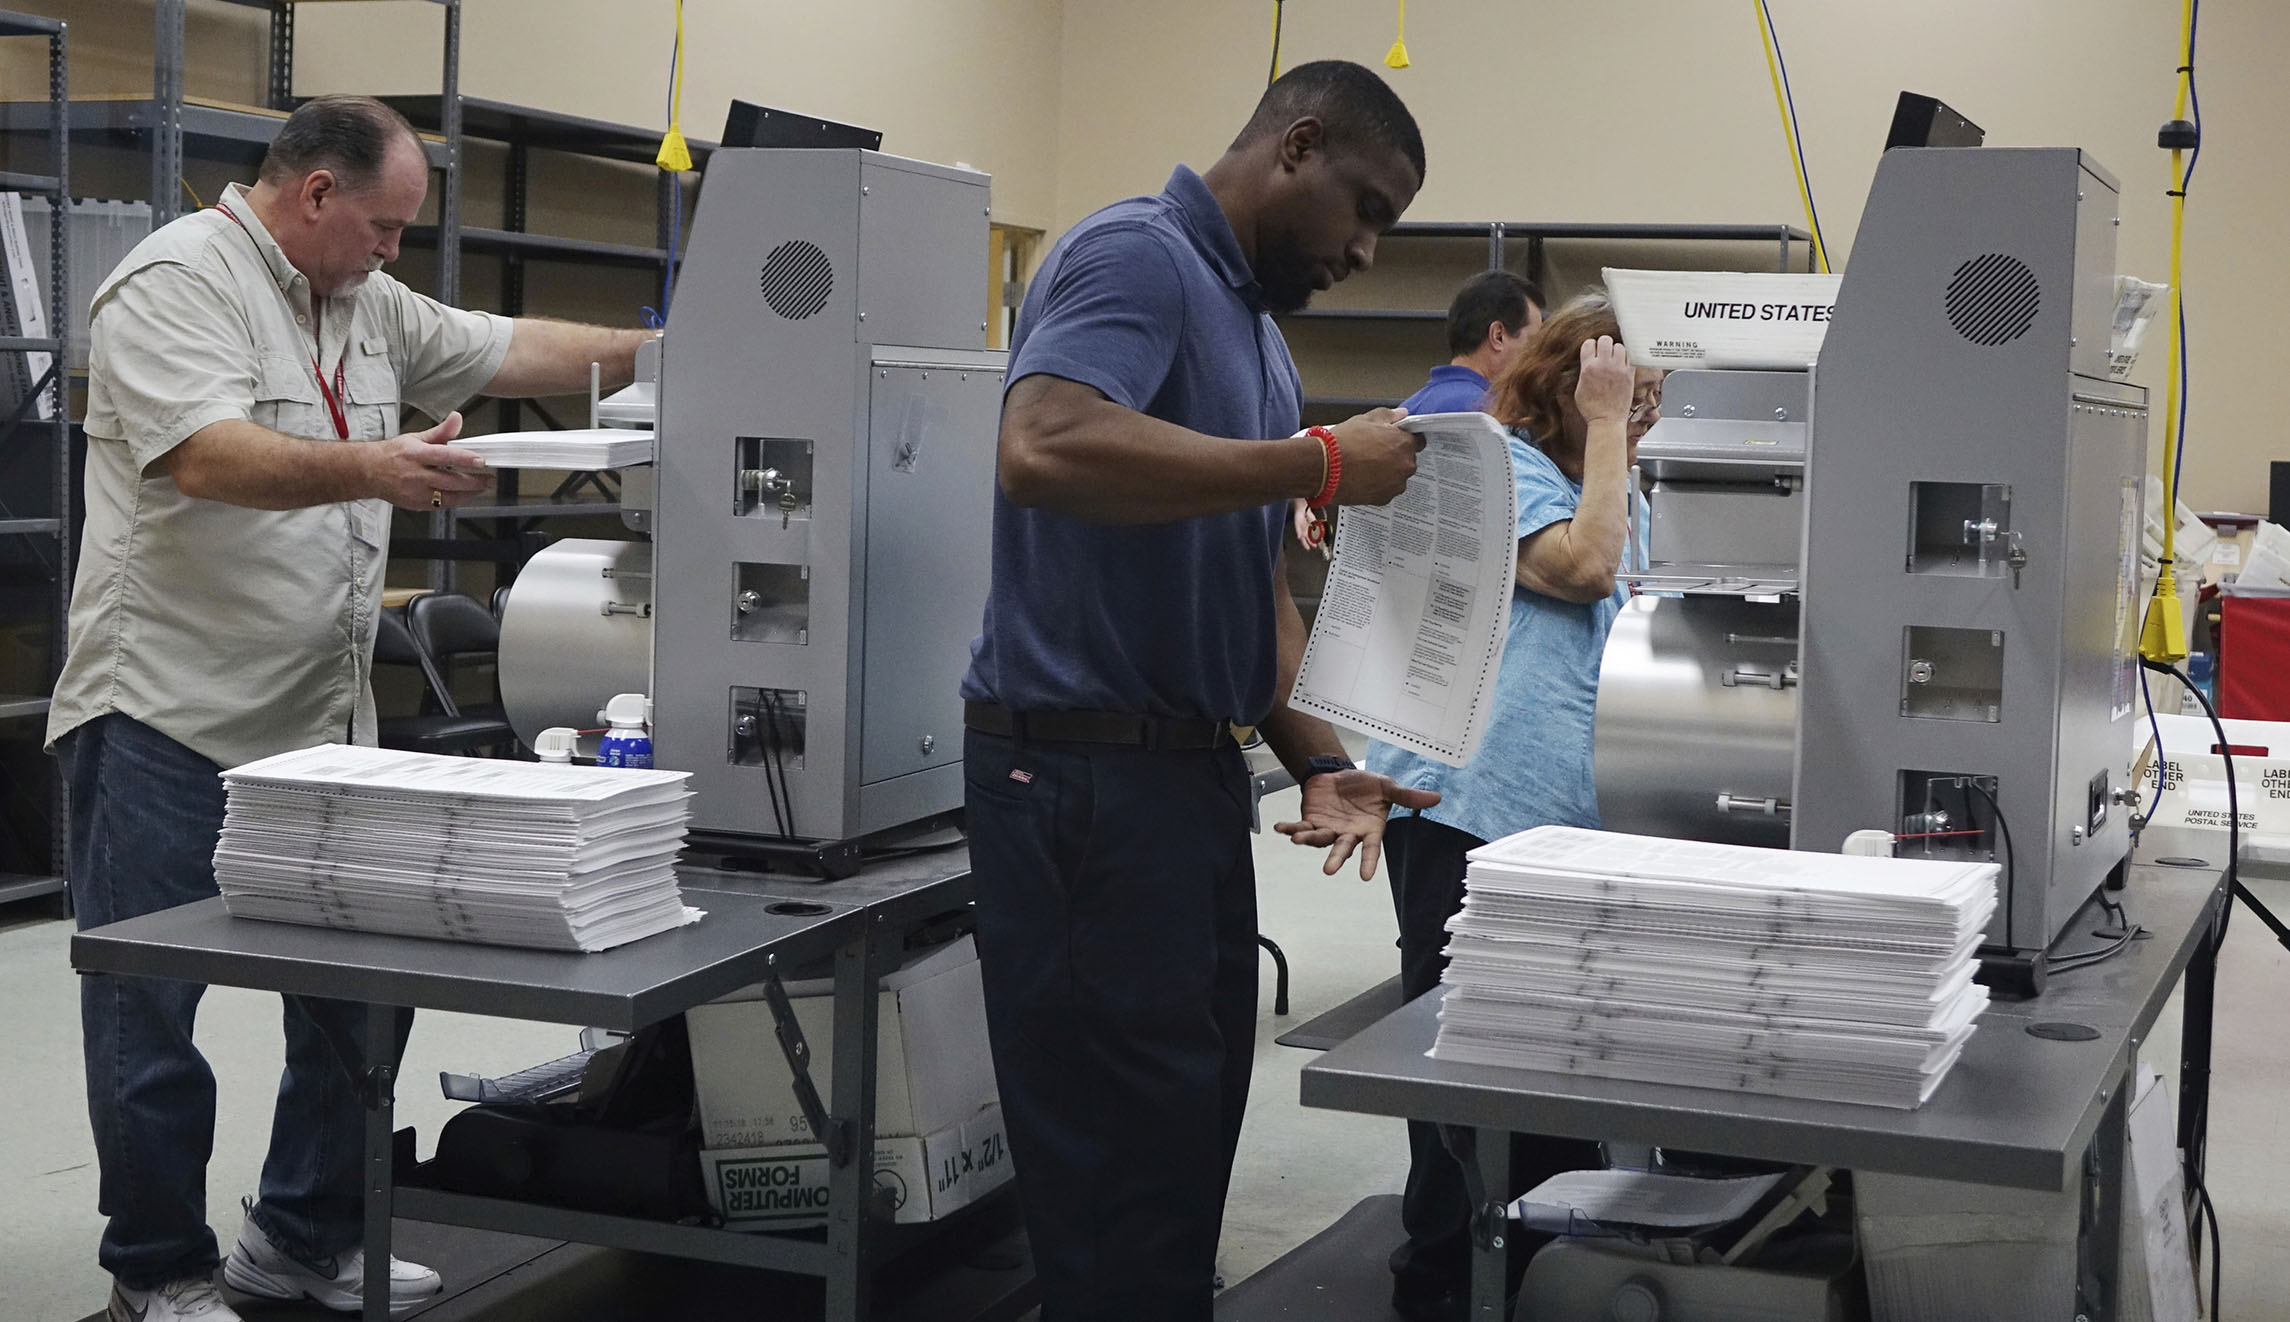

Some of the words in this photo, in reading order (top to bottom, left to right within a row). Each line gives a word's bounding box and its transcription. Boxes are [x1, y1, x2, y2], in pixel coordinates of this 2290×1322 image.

[1684, 302, 1756, 320] UNITED
[1656, 341, 1699, 349] WARNING
[2264, 769, 2290, 778] LABE
[2151, 780, 2176, 791] END
[2261, 779, 2290, 788] OTHE
[2187, 809, 2219, 818] UNITED
[2221, 811, 2255, 821] STTES
[2184, 817, 2218, 826] POSTAL
[2220, 820, 2258, 829] SEVICE
[725, 1164, 800, 1189] FORMS
[729, 1186, 830, 1212] OMPUTER
